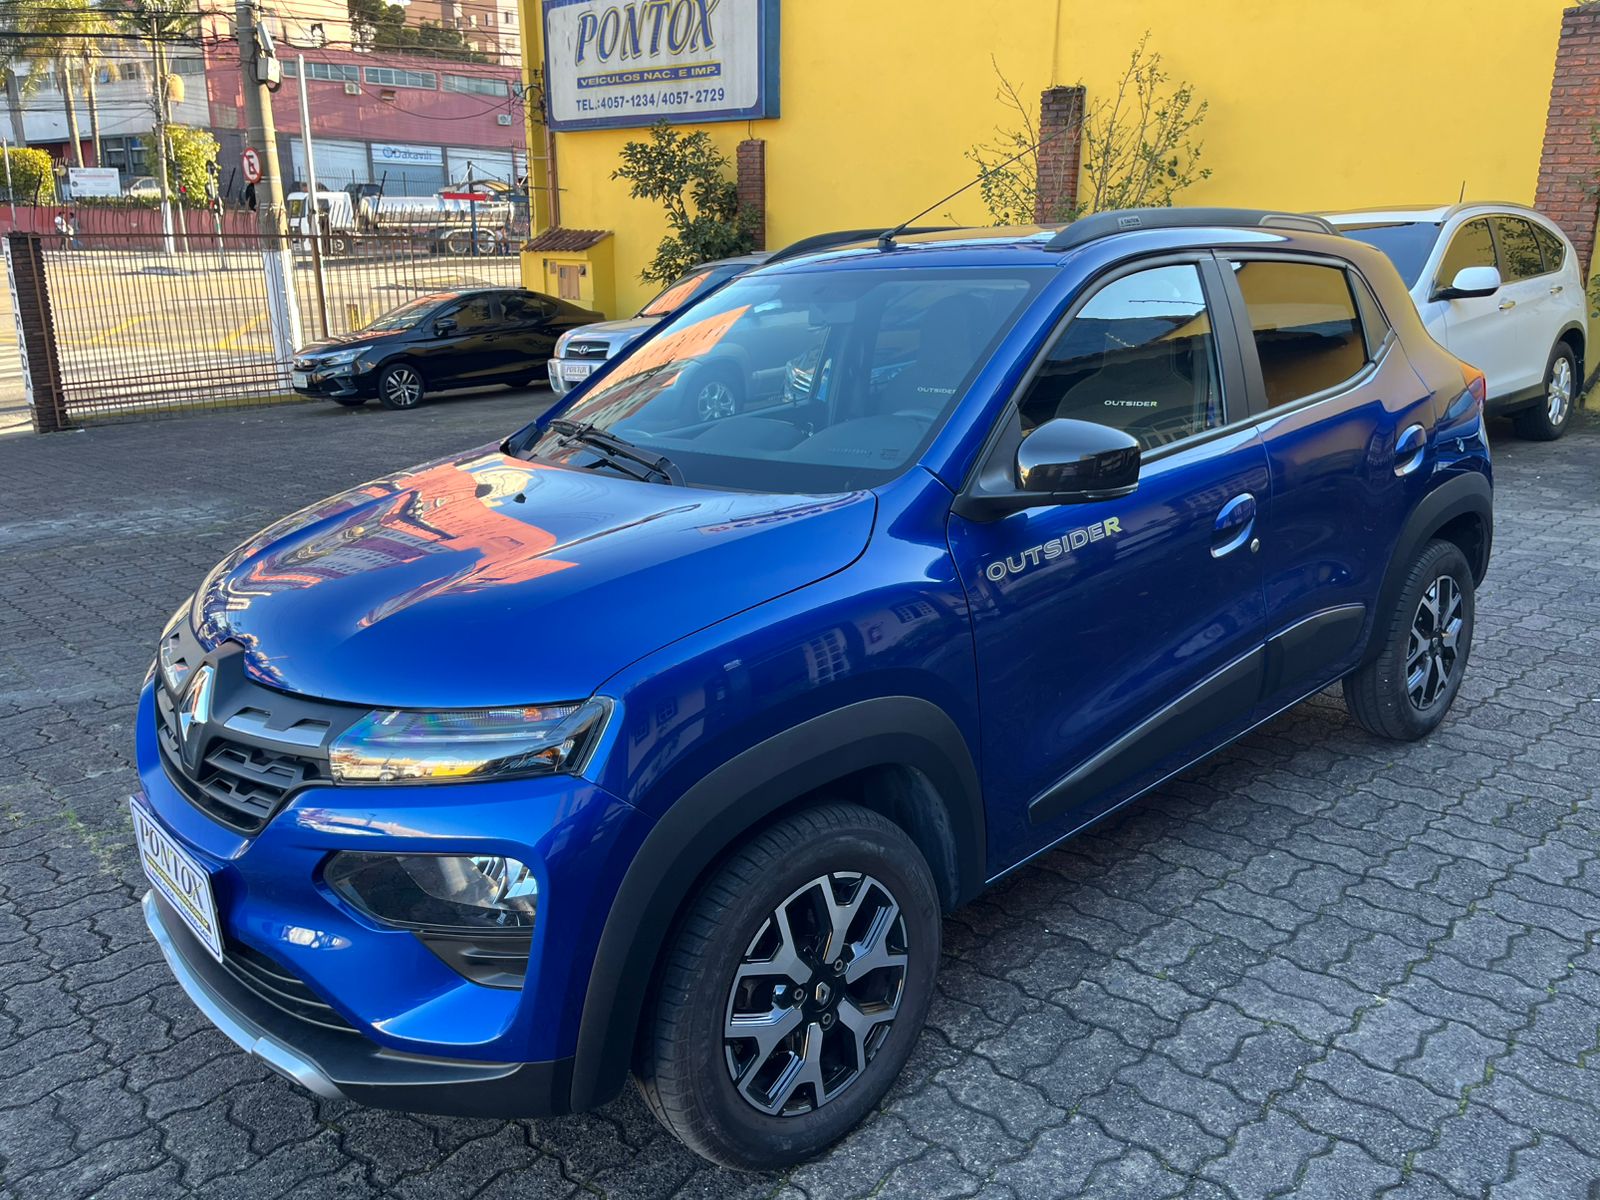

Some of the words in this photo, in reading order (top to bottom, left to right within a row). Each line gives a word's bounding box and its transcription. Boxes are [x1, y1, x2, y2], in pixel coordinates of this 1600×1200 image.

[575, 0, 721, 66] PONTOX
[643, 69, 675, 81] NAC.
[678, 68, 688, 77] E
[691, 65, 719, 76] IMP.
[5, 251, 33, 391] ENTRADA
[986, 516, 1122, 582] OUTSIDER
[138, 815, 206, 913] PONTOX
